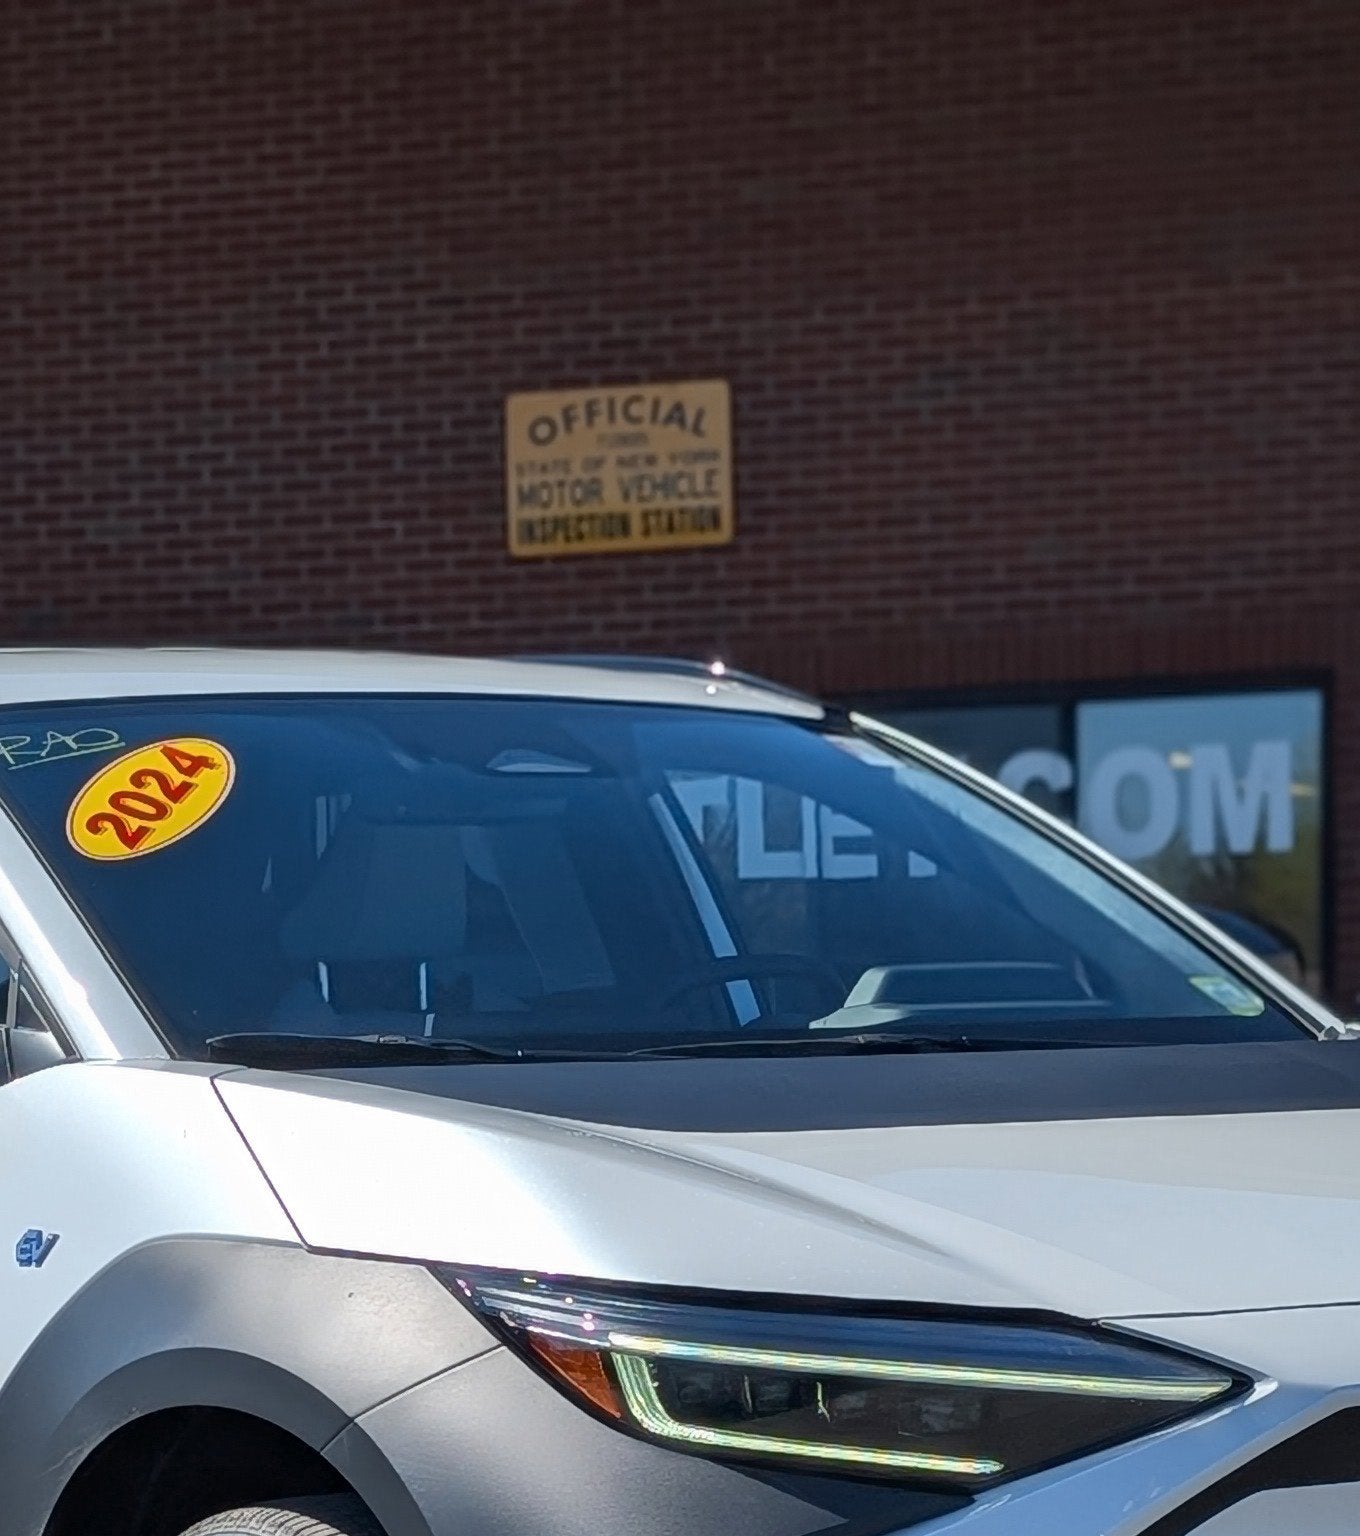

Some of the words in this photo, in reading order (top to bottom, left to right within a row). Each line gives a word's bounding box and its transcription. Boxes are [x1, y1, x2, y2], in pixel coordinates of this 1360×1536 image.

[528, 394, 706, 447] OFFICIAL
[516, 476, 605, 511] MOTOR
[616, 468, 719, 503] VEHICLE
[516, 511, 631, 545] INSPECTION
[640, 505, 722, 539] STATION
[85, 742, 223, 850] 2024
